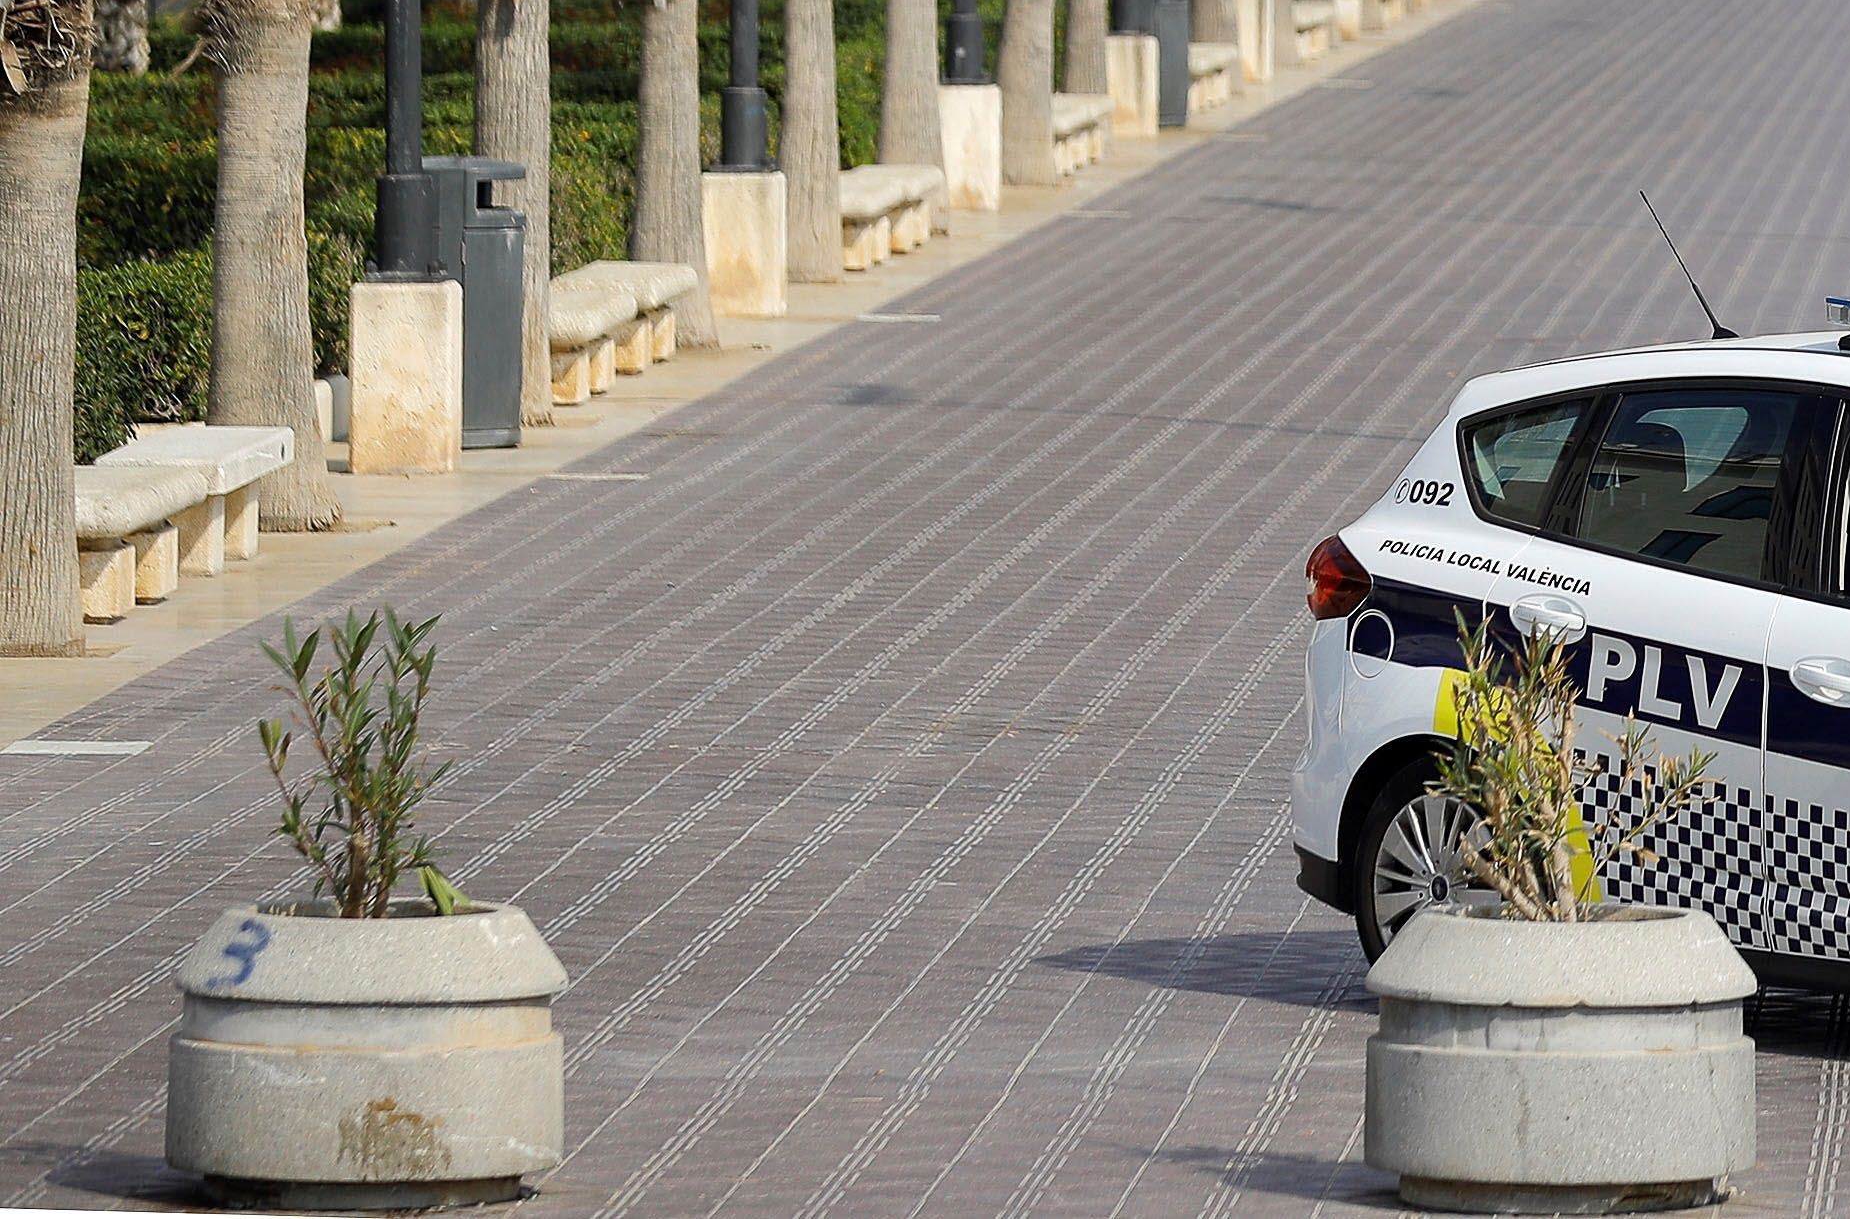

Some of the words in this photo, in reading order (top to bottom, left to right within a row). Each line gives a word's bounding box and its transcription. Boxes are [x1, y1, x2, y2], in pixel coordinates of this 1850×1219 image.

[1409, 479, 1455, 507] 092
[1379, 539, 1444, 562] POLICIA
[1447, 551, 1501, 575] LOCAL
[1586, 632, 1743, 730] PLV
